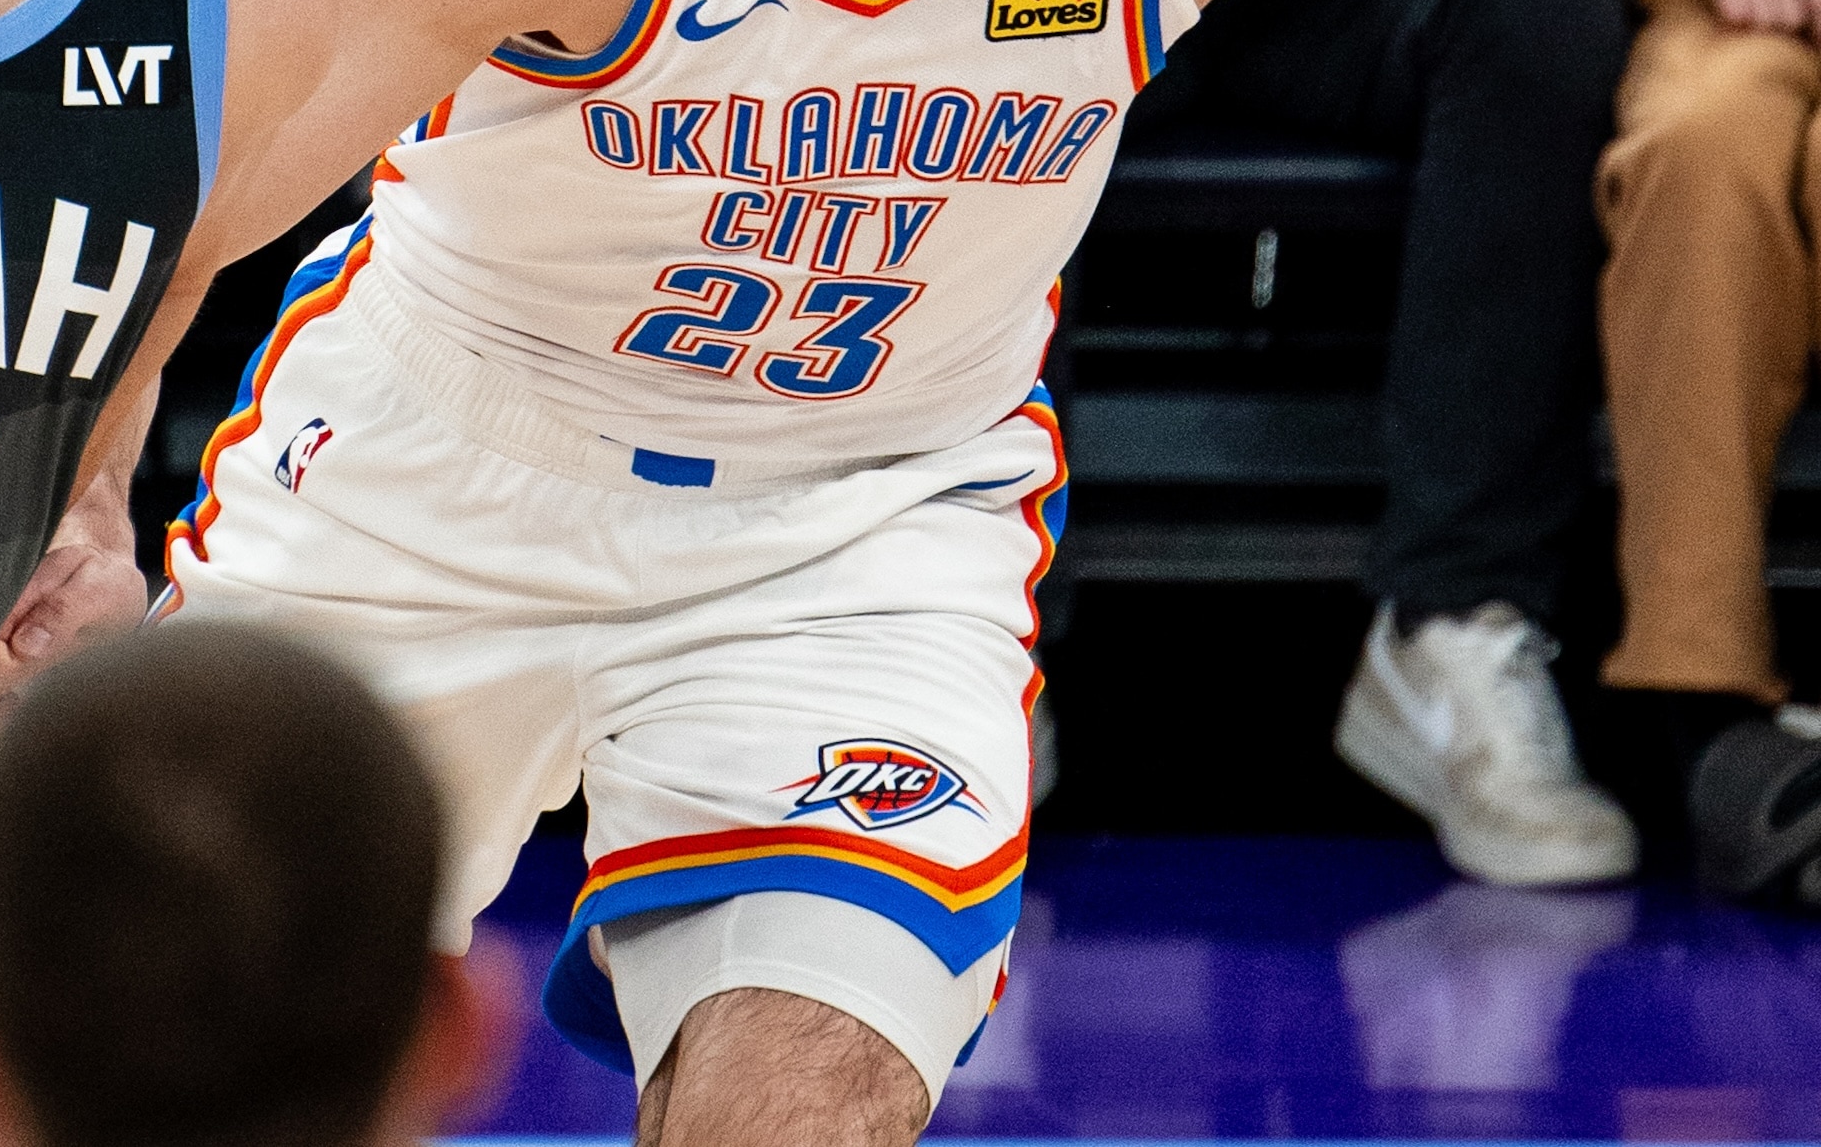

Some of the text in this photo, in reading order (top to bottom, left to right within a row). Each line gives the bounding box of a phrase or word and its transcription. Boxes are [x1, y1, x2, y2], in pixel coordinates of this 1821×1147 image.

[62, 45, 173, 106] LVT
[581, 83, 1117, 186] OKLAHOMA
[700, 189, 948, 274] CITY
[612, 263, 927, 400] 23
[794, 761, 933, 806] OKC
